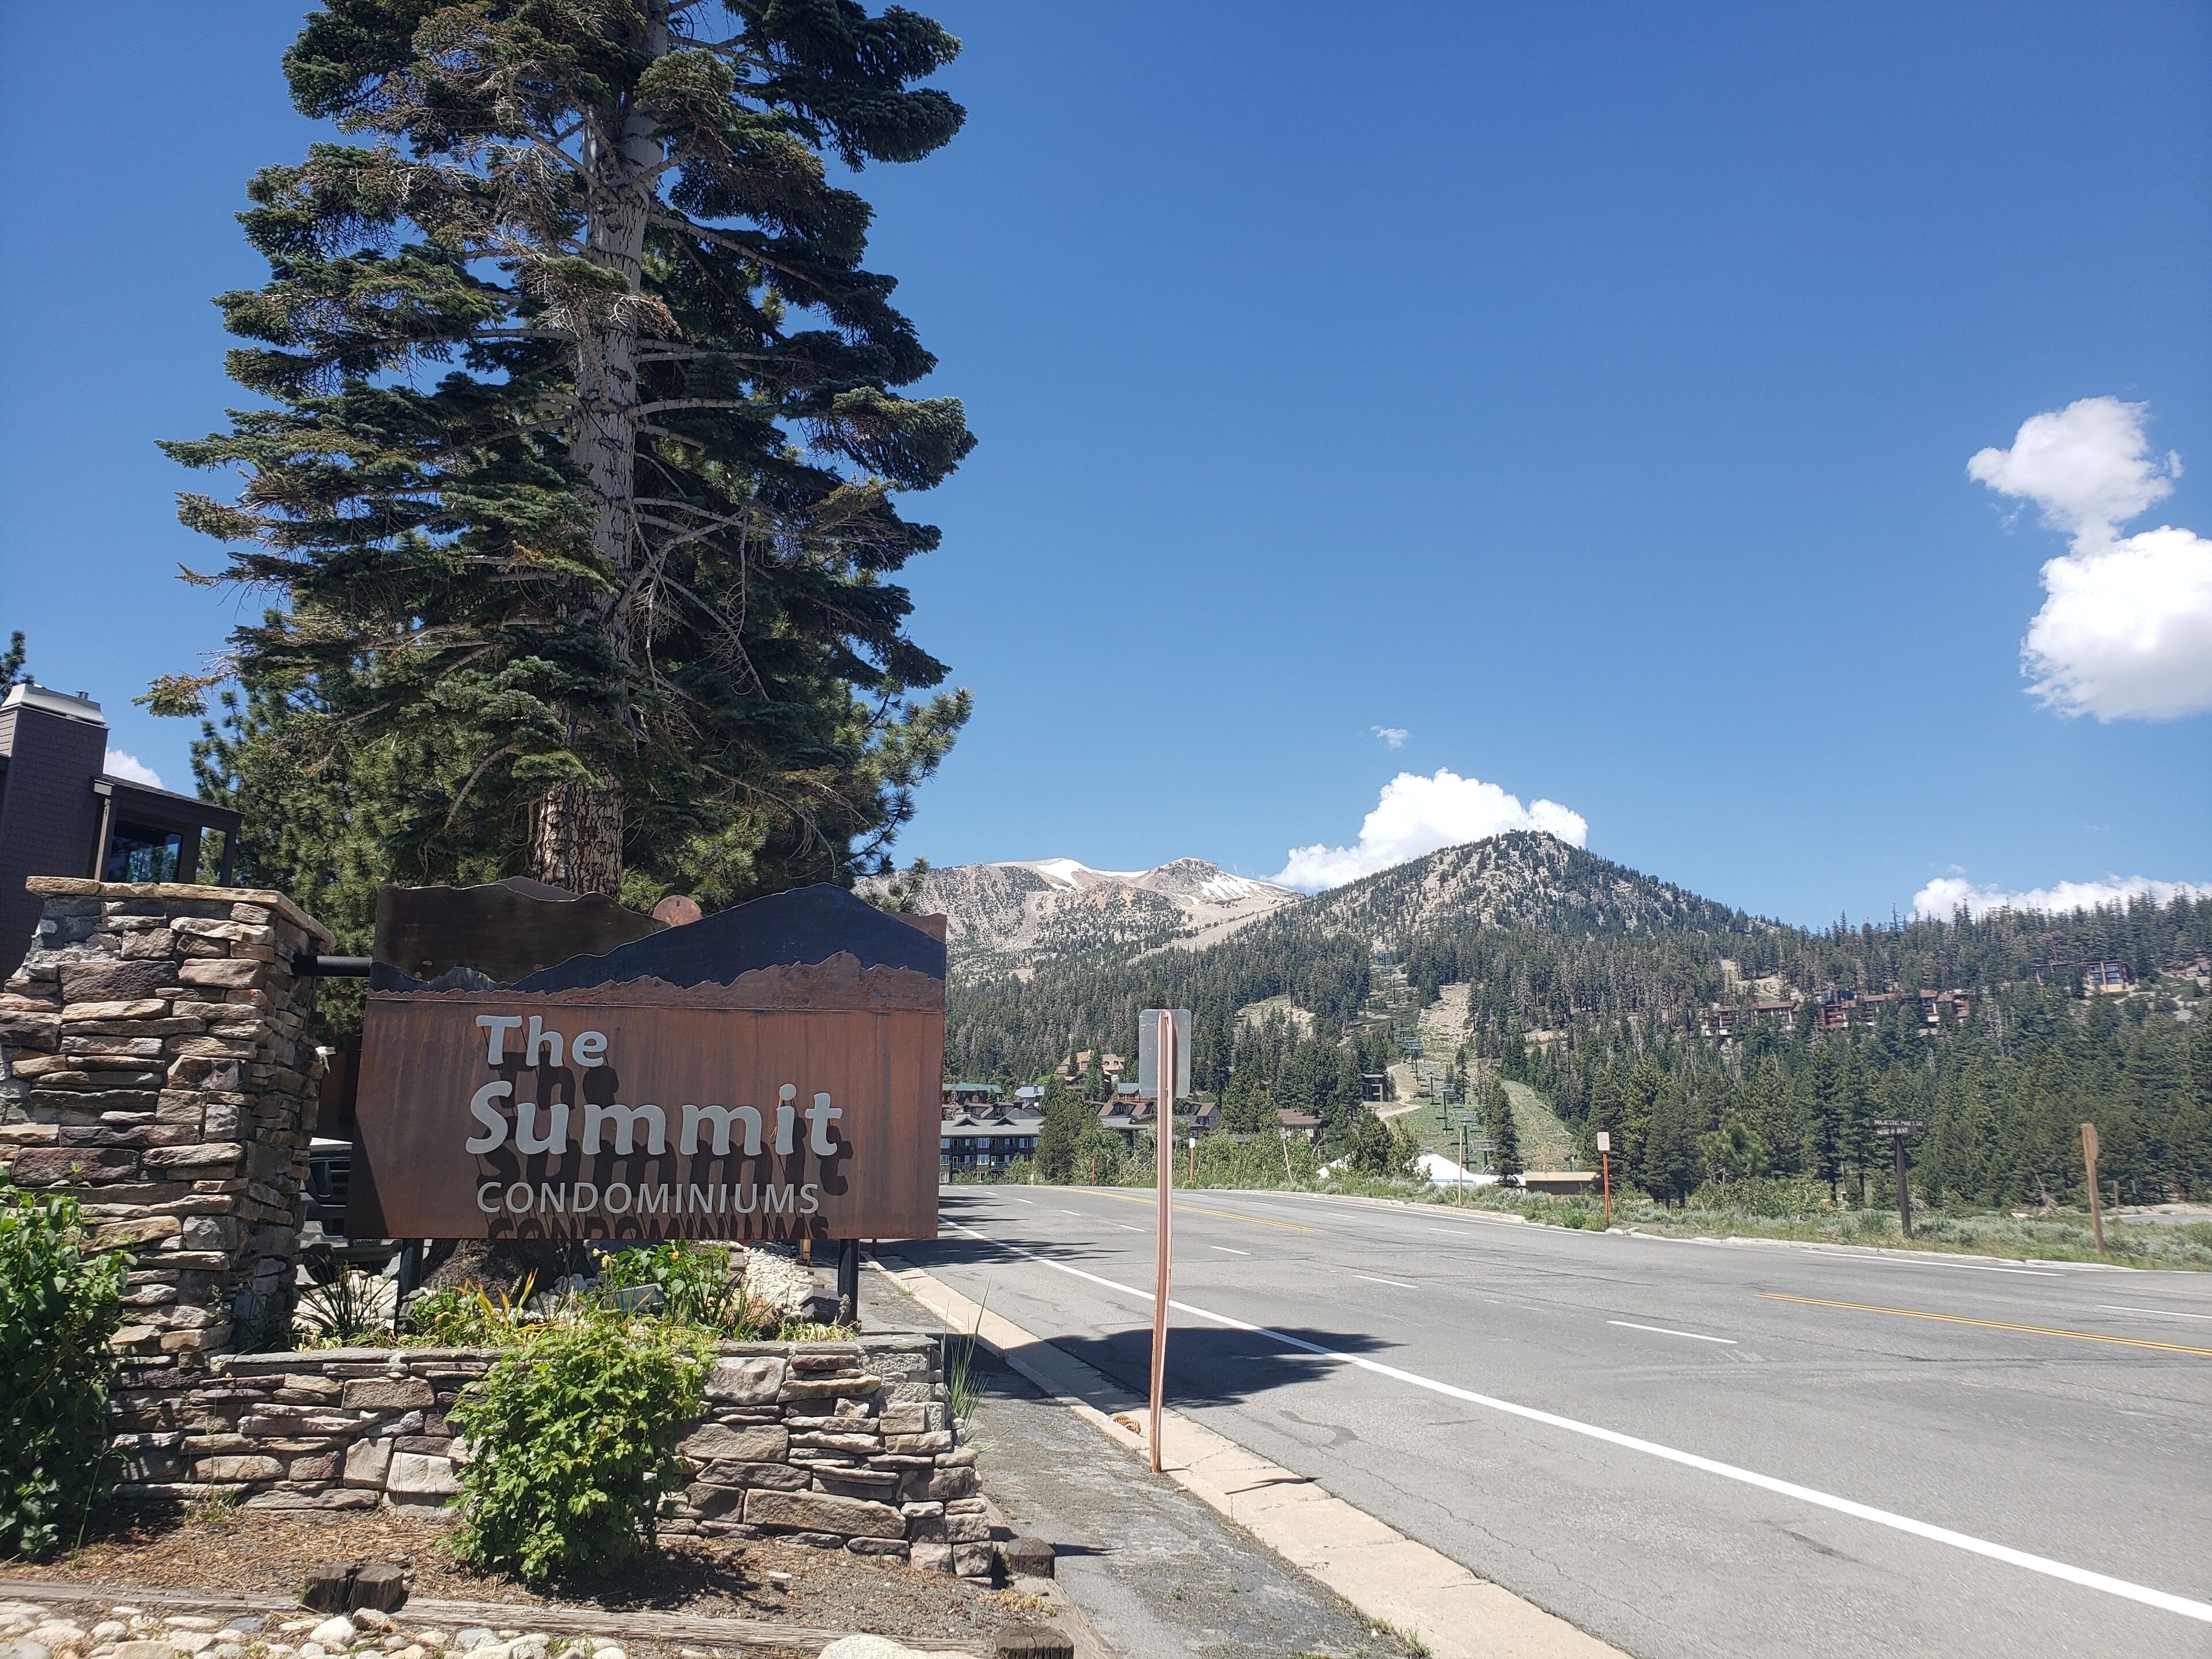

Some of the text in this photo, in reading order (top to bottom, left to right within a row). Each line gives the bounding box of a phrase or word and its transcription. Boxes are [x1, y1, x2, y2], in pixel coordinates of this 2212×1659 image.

[476, 1015, 608, 1067] The
[465, 1081, 843, 1156] Summit
[477, 1182, 820, 1214] CONDOMINIUMS
